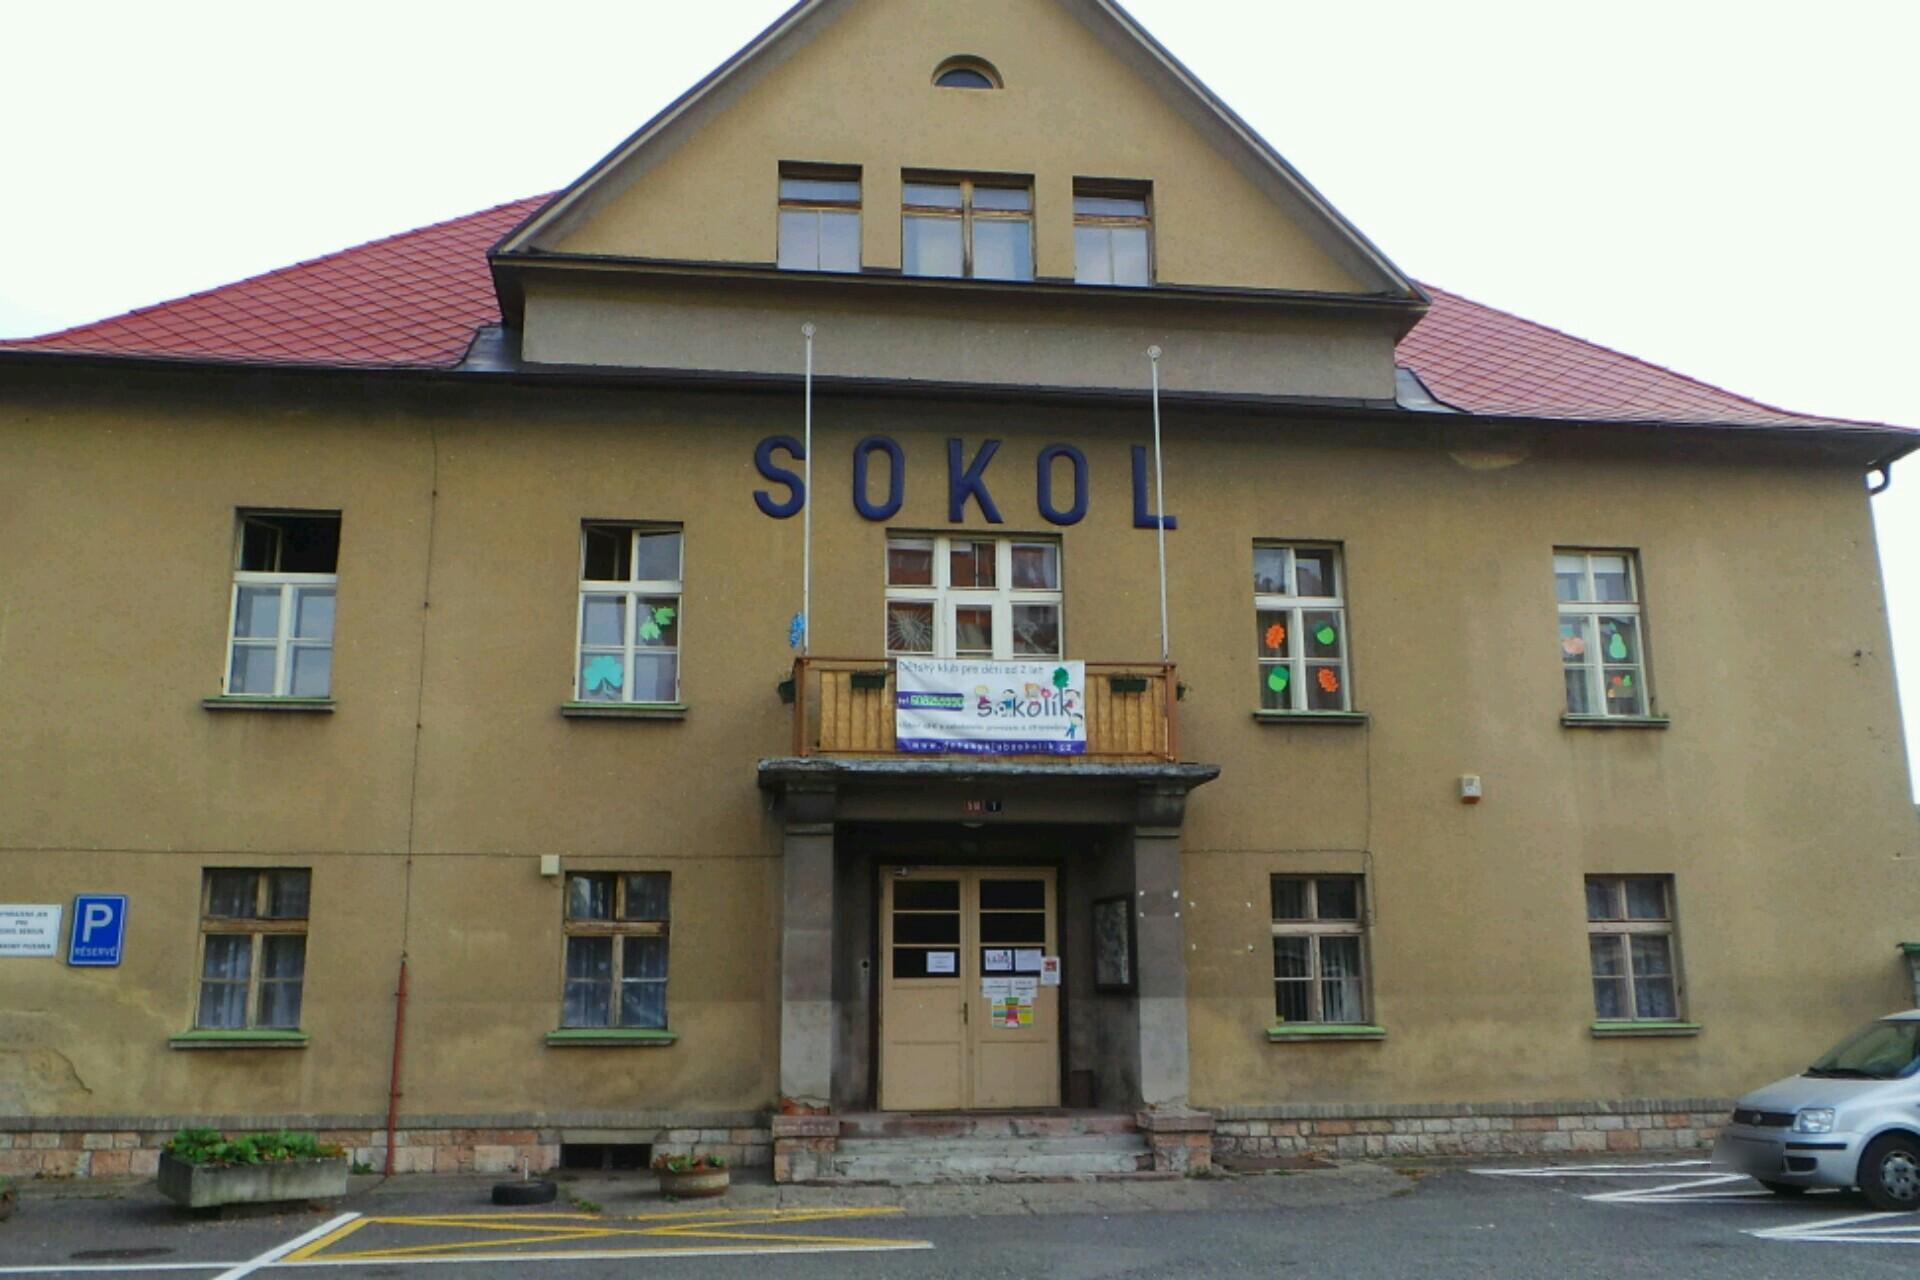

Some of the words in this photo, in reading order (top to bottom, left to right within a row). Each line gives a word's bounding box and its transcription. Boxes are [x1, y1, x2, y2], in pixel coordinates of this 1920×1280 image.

[753, 435, 1178, 530] SOKOL
[938, 662, 959, 674] klub
[961, 665, 979, 676] pro
[1005, 665, 1018, 674] od
[1020, 665, 1027, 674] 2
[82, 903, 113, 943] P
